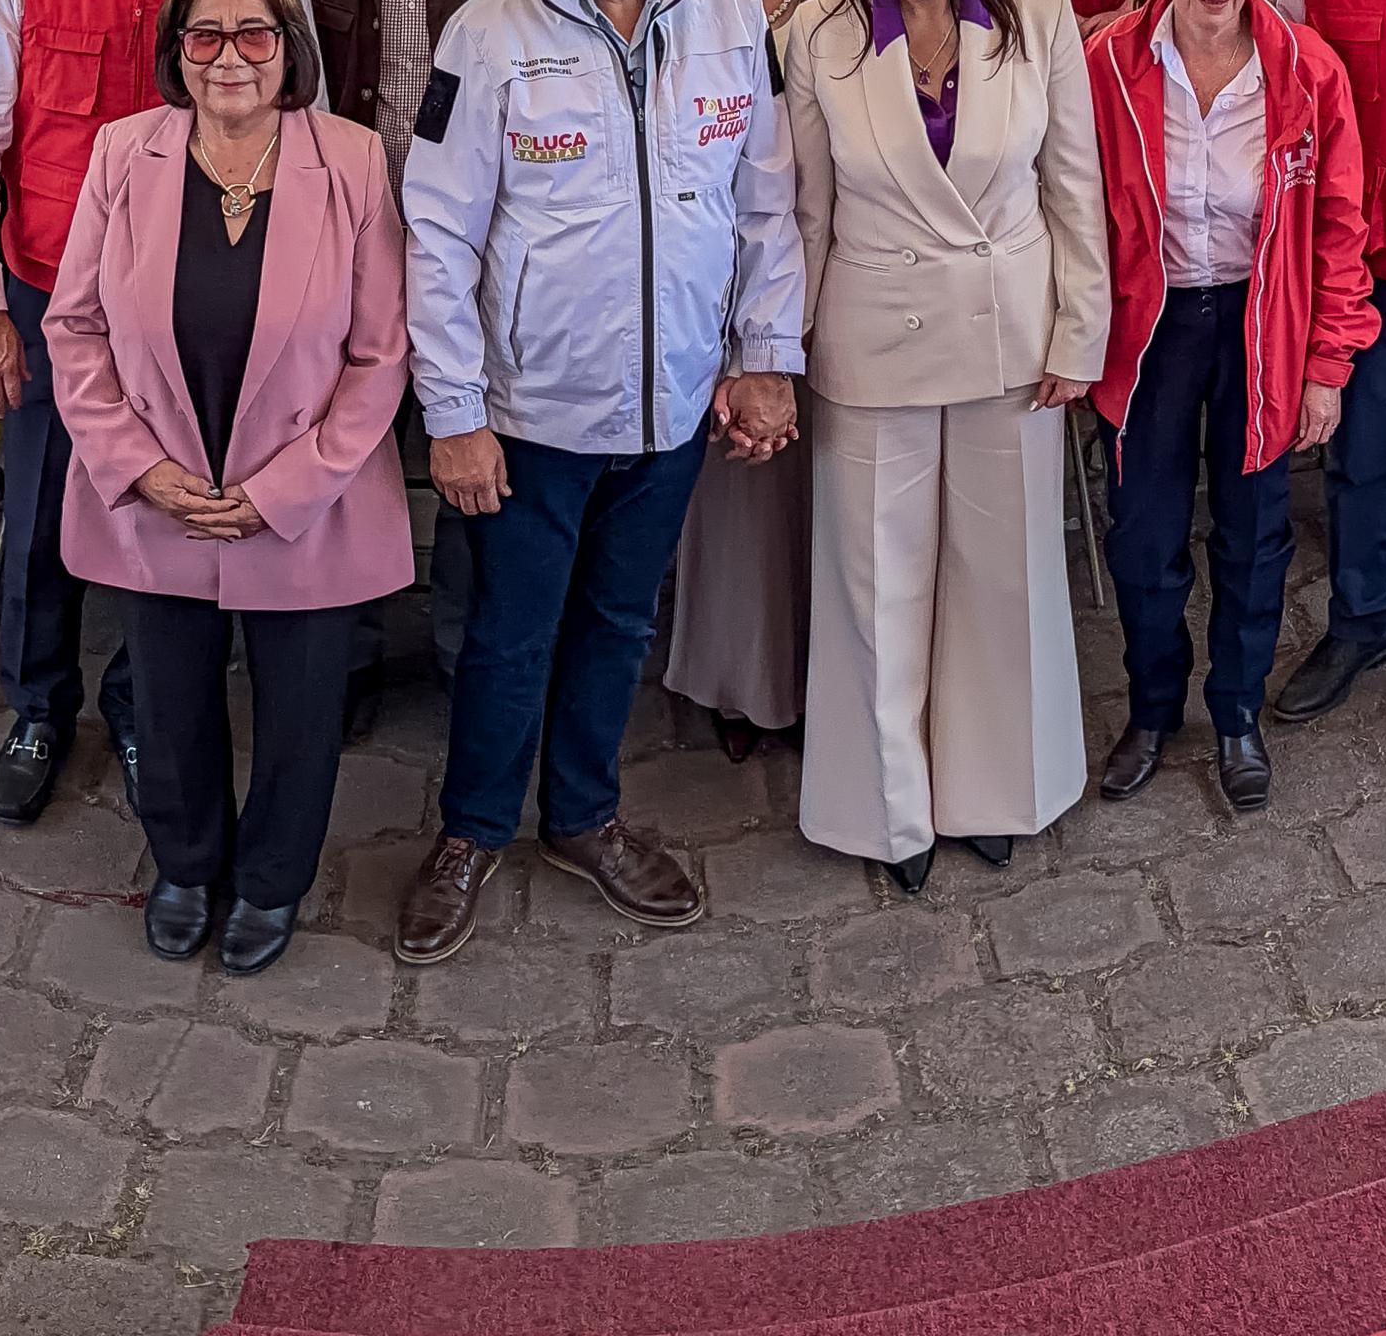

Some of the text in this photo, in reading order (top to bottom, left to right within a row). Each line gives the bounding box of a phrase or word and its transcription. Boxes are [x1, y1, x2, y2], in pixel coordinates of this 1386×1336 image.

[693, 93, 753, 116] TOLUCA
[506, 131, 588, 151] TOLUCA
[514, 148, 583, 159] CAPITAL
